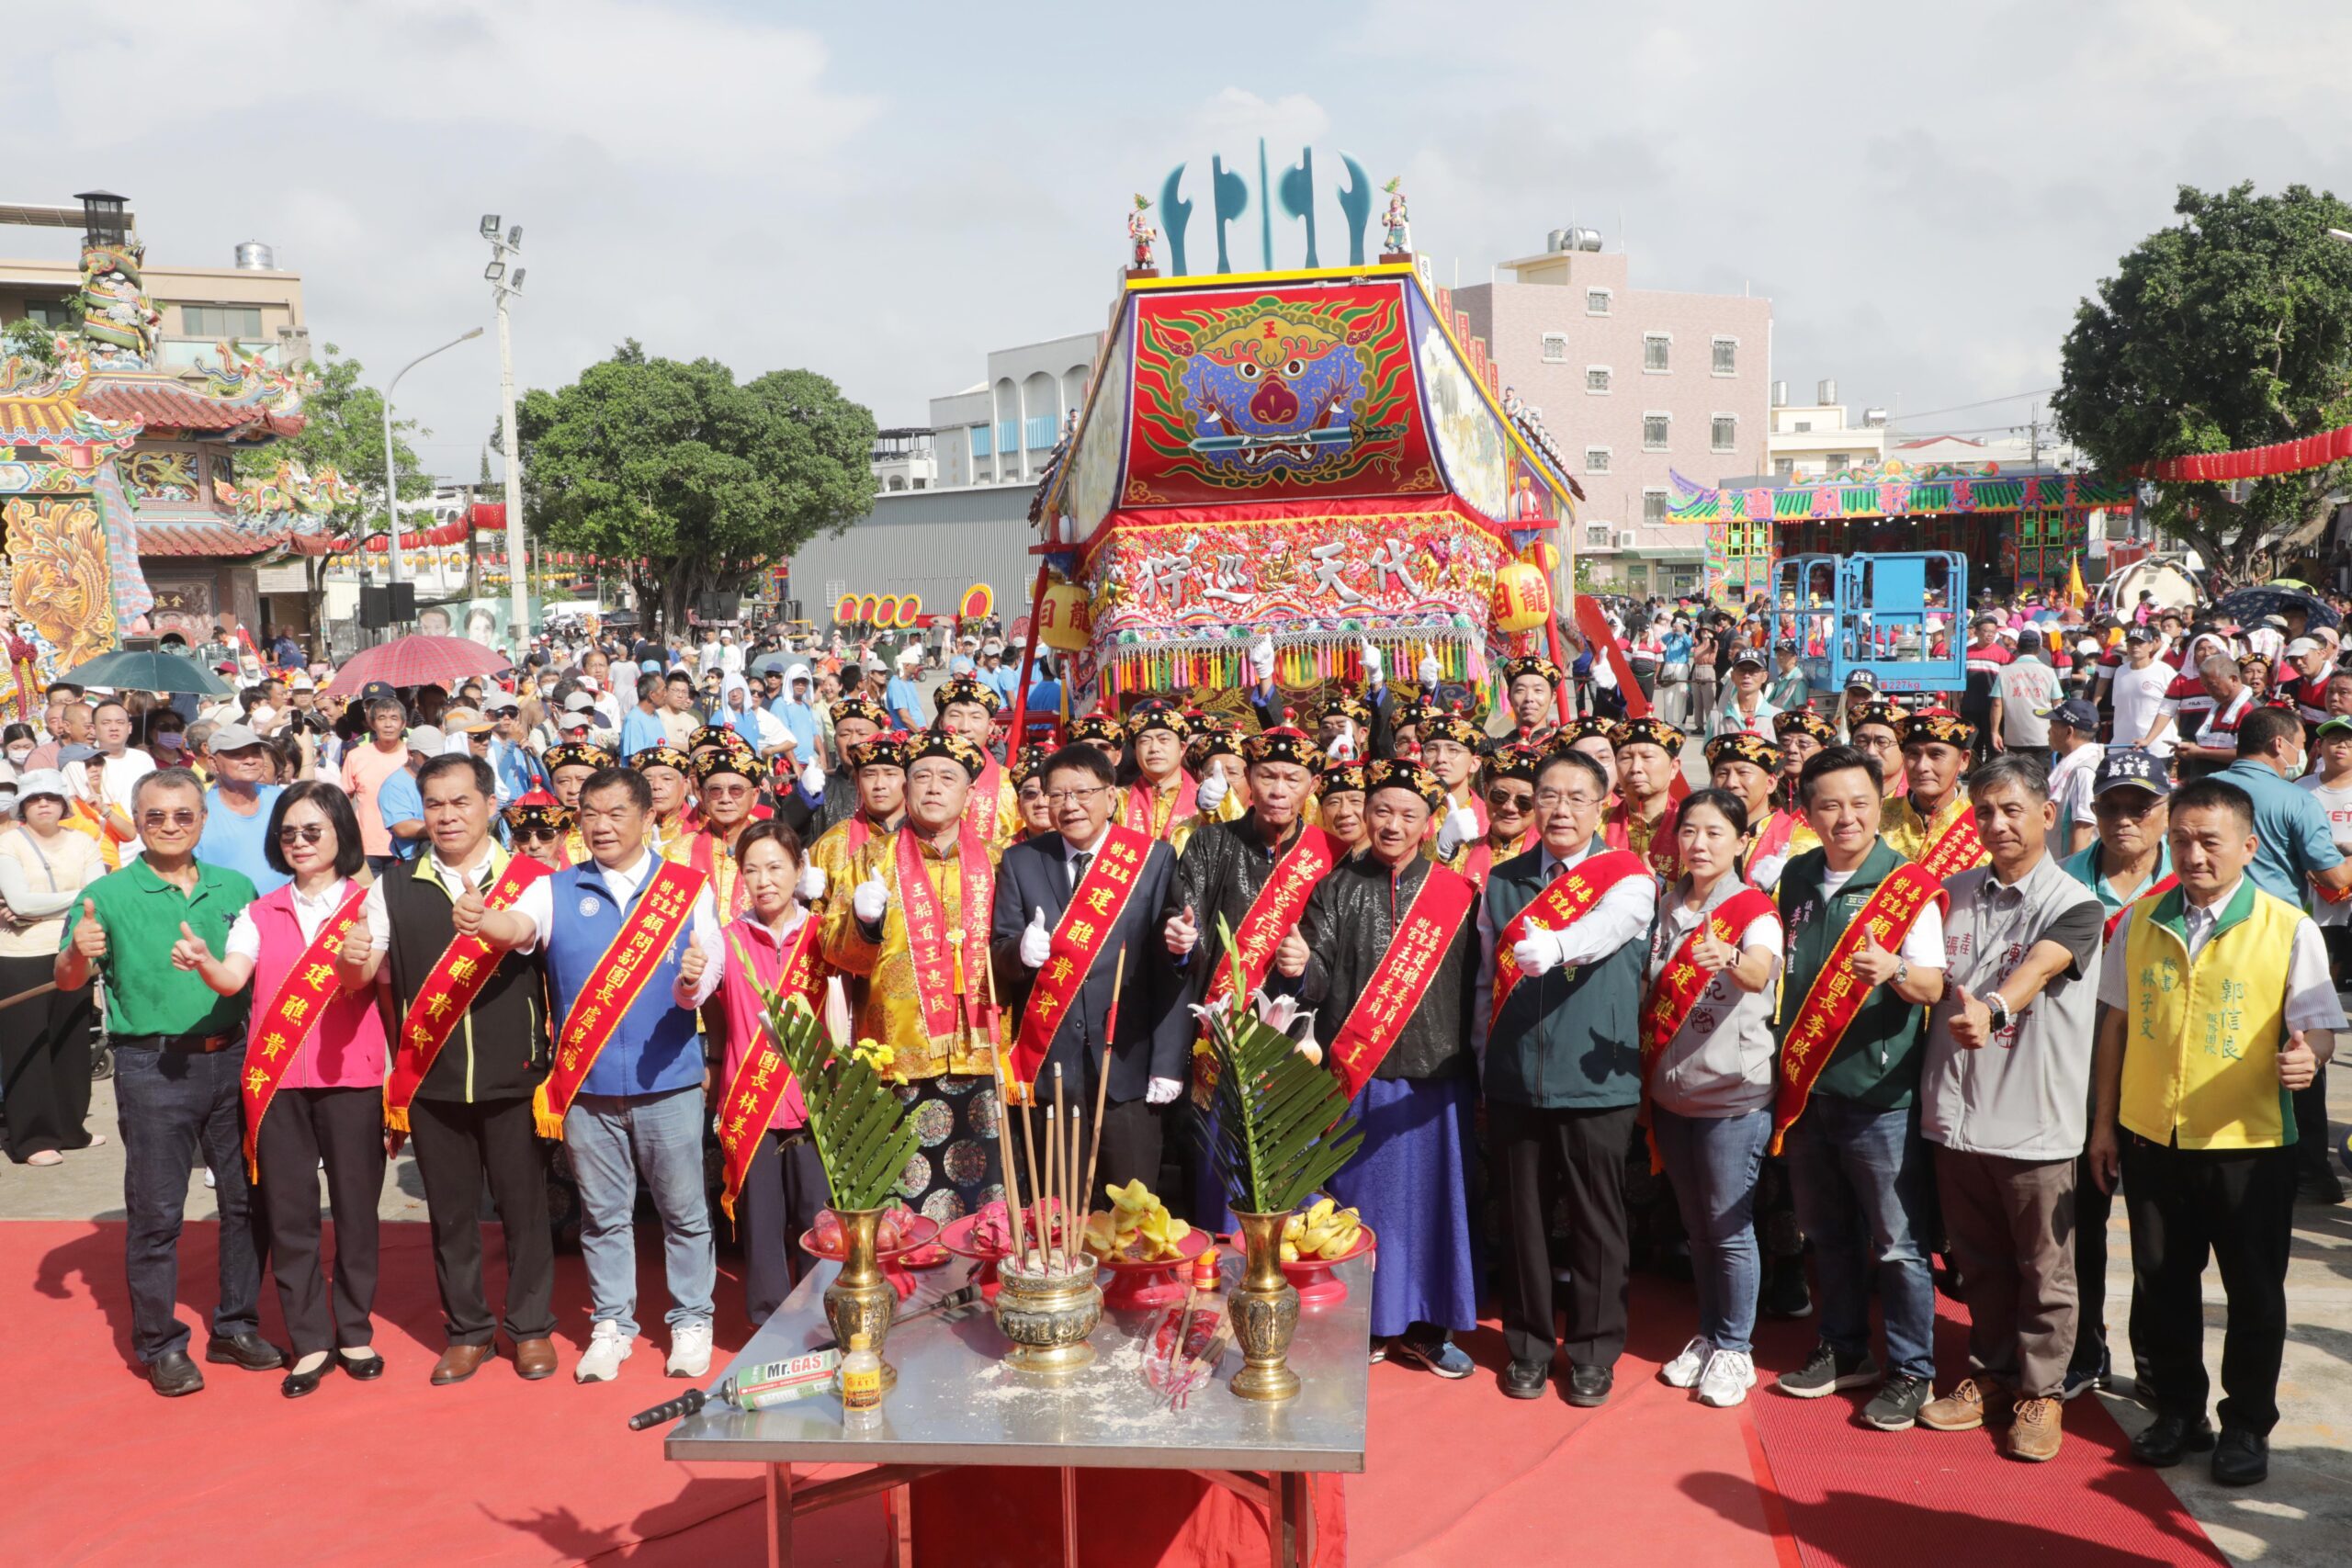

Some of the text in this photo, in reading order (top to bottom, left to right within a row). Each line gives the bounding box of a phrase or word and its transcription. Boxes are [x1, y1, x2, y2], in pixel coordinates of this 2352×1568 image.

[1263, 321, 1278, 339] 王
[1036, 887, 1116, 1022] 建醮貴賓
[246, 963, 334, 1100] 建醮貴賓
[2220, 978, 2243, 1060] 郭信良
